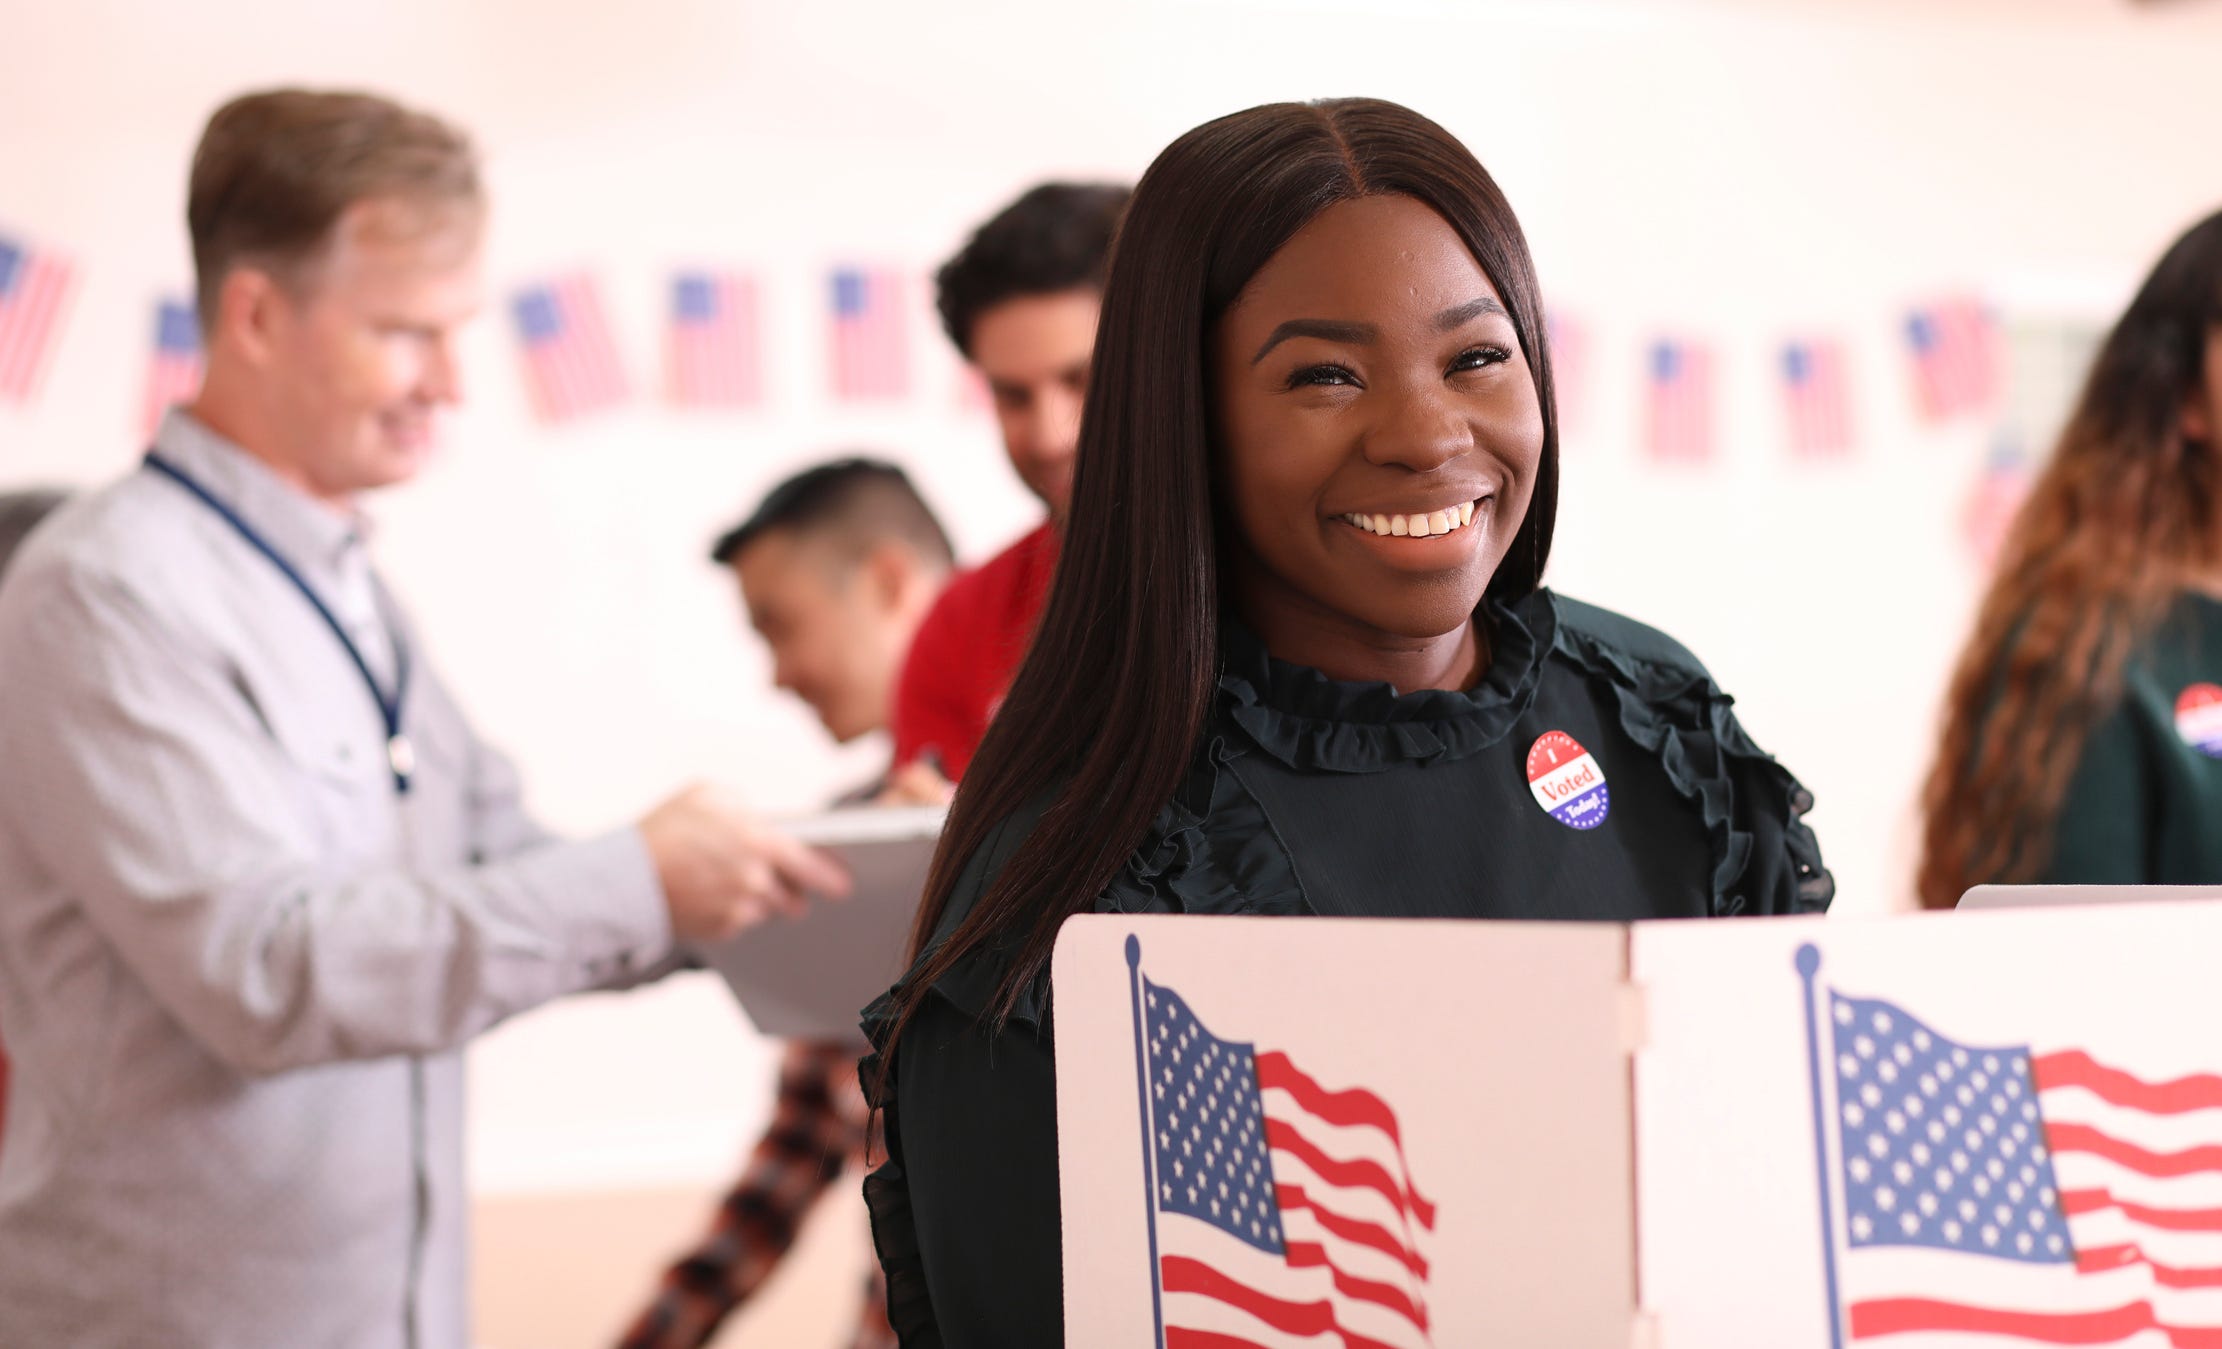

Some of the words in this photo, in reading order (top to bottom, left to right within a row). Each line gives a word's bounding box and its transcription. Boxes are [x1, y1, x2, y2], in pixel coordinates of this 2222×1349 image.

[1547, 748, 1558, 764] I
[1541, 764, 1595, 801] Voted
[1565, 792, 1601, 818] Today!
